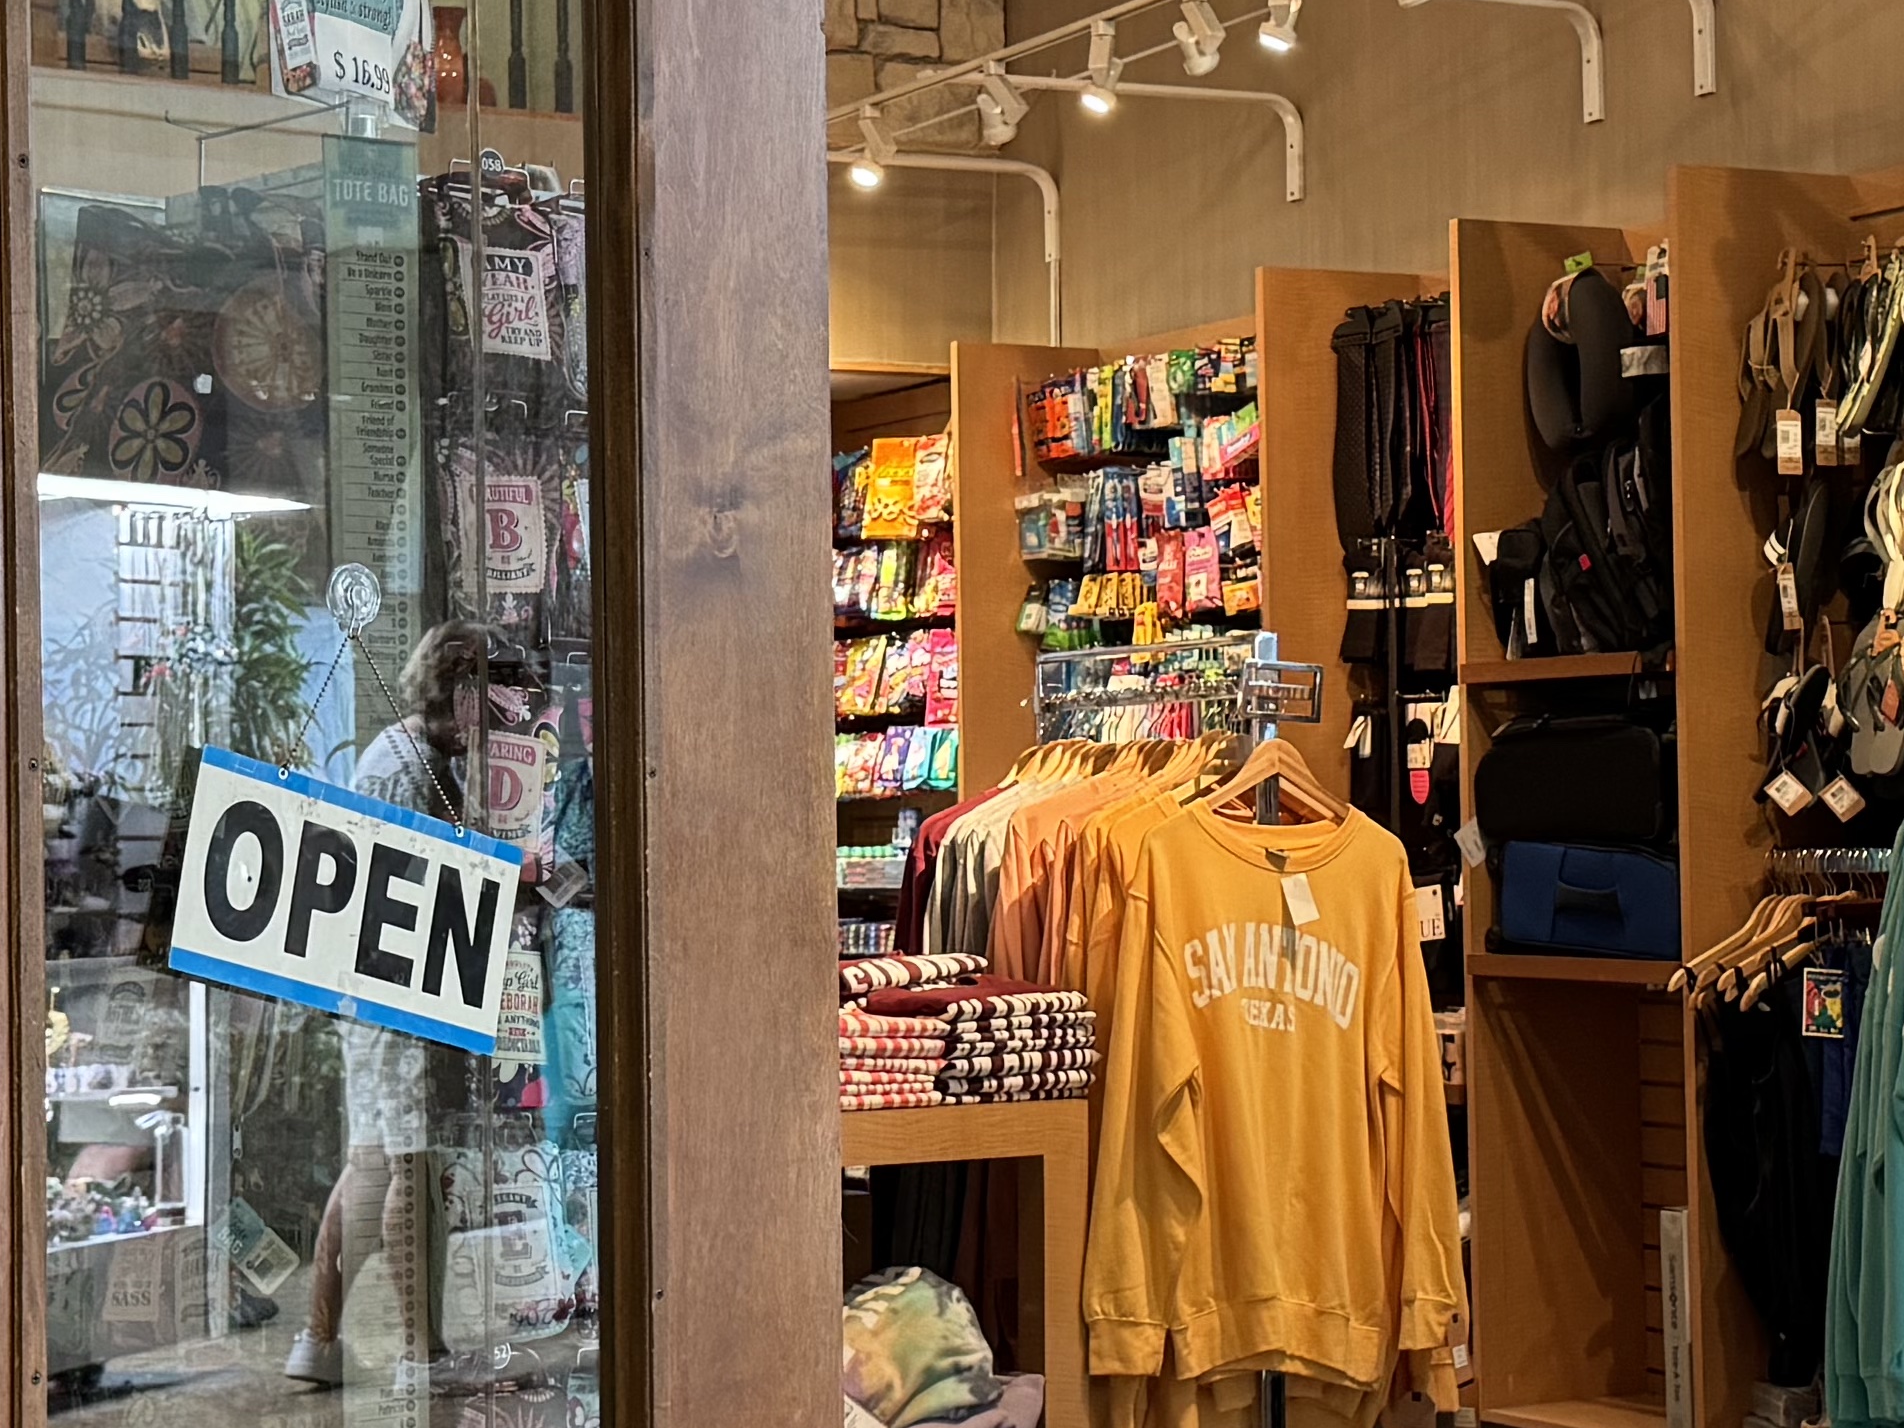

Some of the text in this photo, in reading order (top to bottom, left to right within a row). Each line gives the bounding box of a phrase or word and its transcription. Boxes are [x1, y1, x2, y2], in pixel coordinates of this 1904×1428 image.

[334, 50, 391, 96] $ 16.99
[481, 157, 503, 172] 058
[333, 178, 409, 208] TOTE BAG
[485, 507, 523, 553] B
[203, 800, 501, 1010] OPEN
[1183, 922, 1240, 1011] SAN
[112, 1290, 151, 1308] SASS
